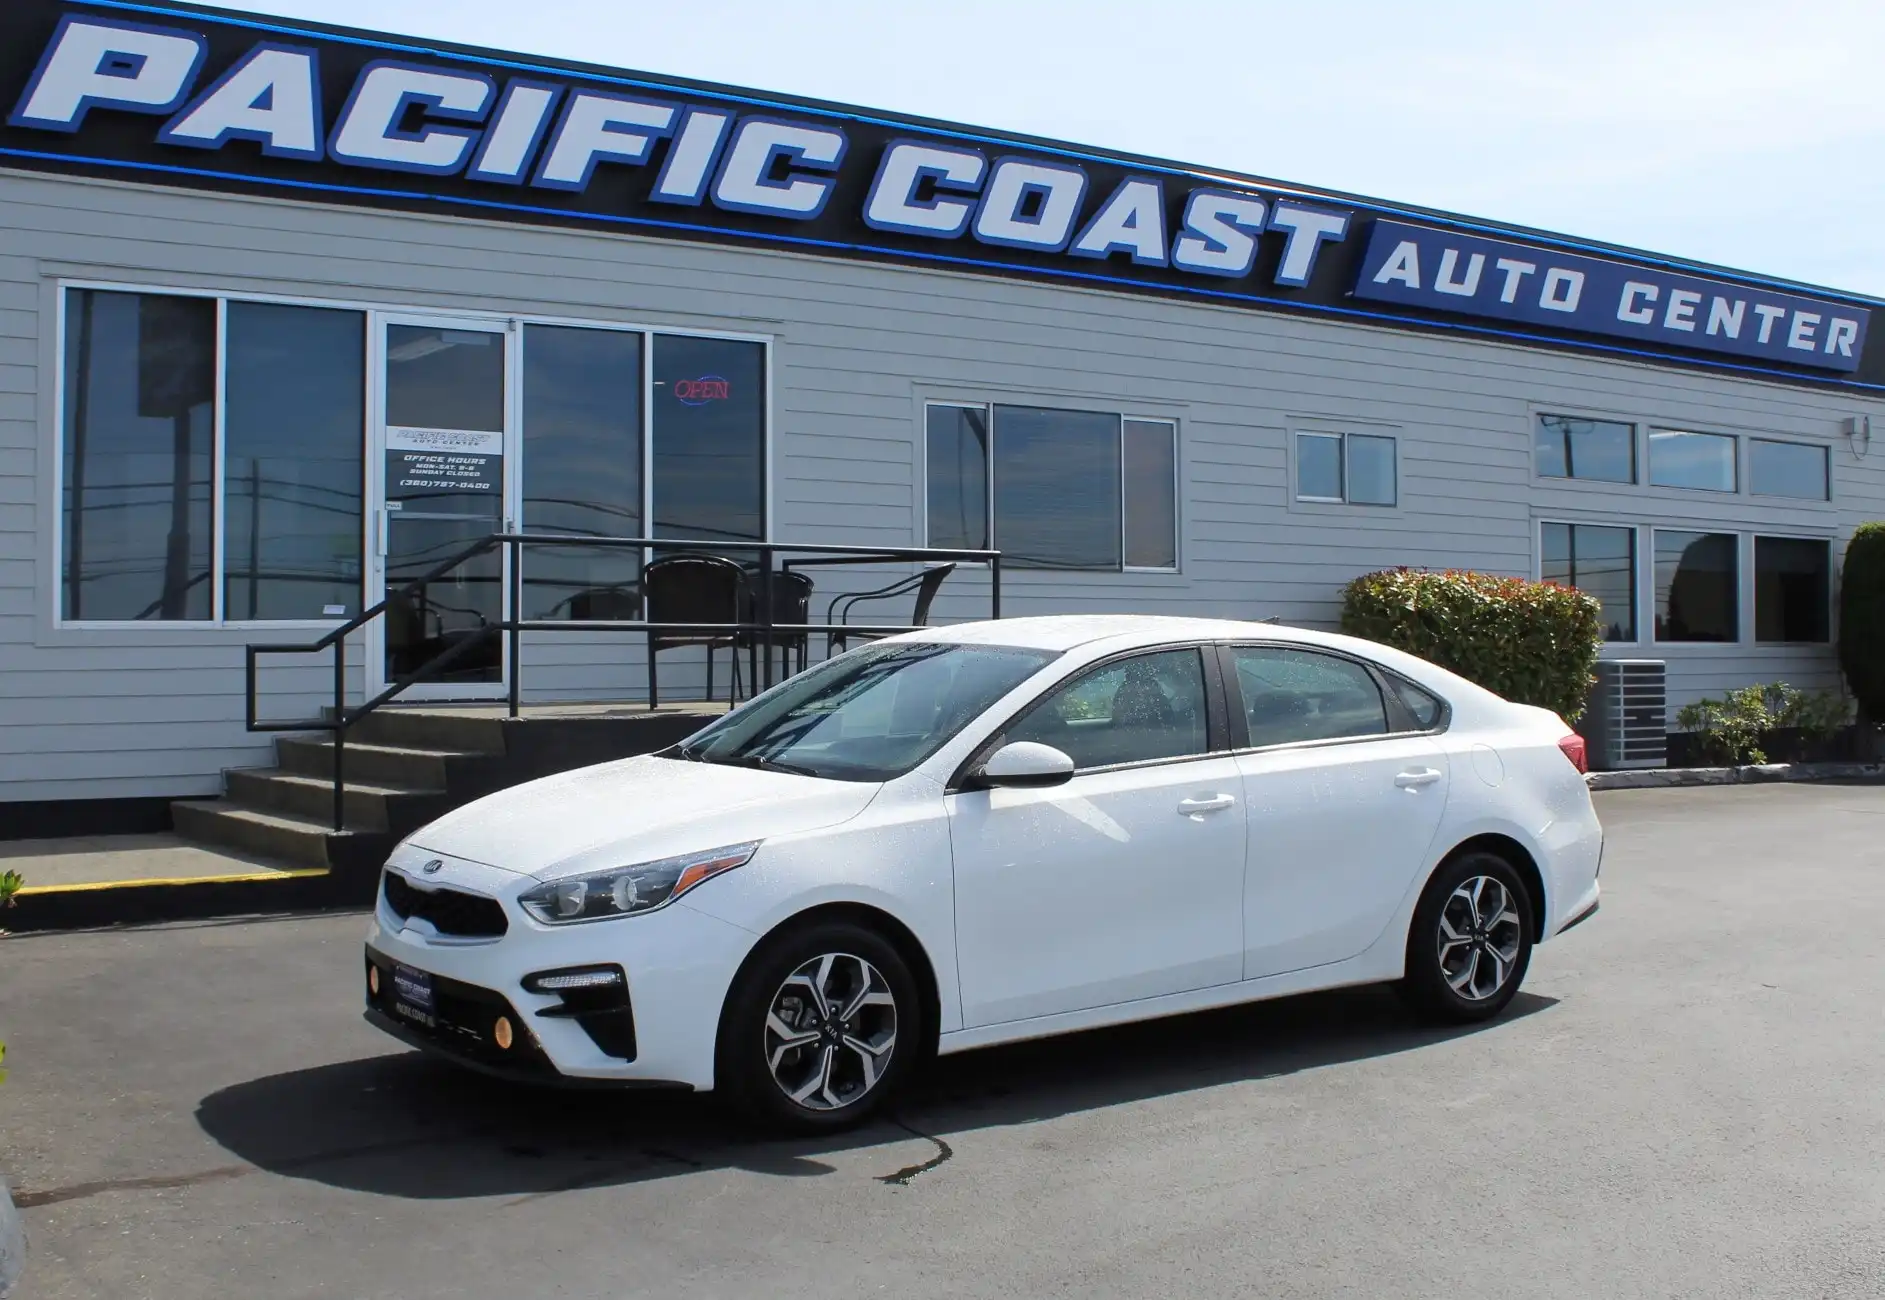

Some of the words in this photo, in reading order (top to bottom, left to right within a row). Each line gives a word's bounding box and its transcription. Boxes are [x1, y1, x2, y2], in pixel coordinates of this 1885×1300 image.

[10, 16, 846, 218] PACIFIC
[864, 140, 1351, 286] COAST
[1373, 242, 1585, 313] AUTO
[1617, 281, 1859, 357] CENTER
[675, 380, 729, 399] OPEN
[404, 455, 445, 463] OFFICE
[448, 457, 487, 465] HOURS
